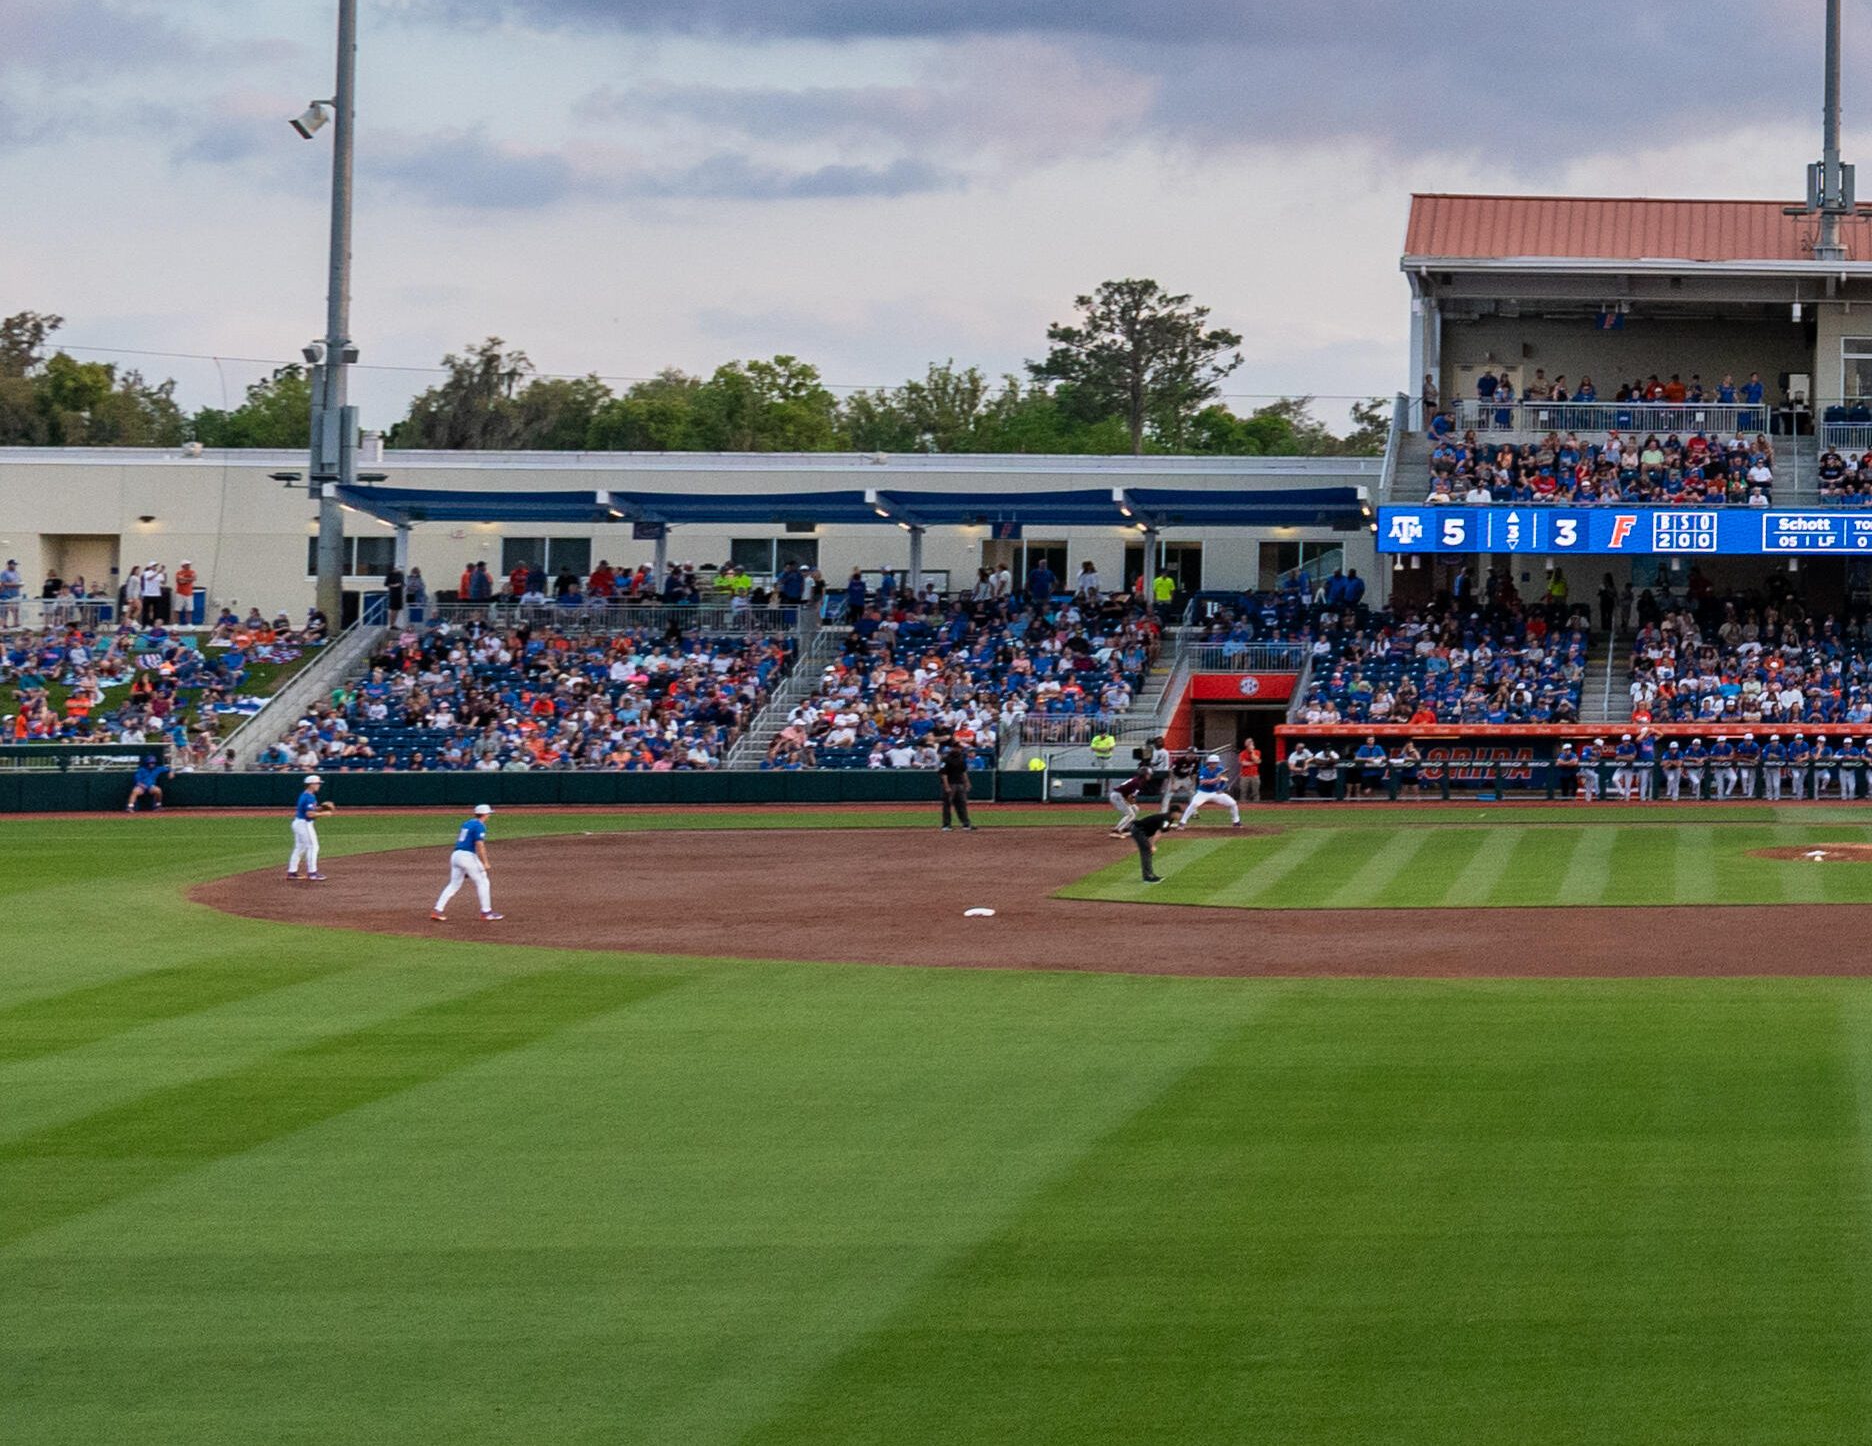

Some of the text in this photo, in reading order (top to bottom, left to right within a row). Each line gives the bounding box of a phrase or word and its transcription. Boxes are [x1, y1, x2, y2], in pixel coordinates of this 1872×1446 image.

[1442, 518, 1465, 545] 5
[1507, 525, 1519, 540] 3
[1555, 519, 1577, 546] 3
[1608, 515, 1637, 548] F
[1778, 518, 1831, 531] Schott
[1818, 536, 1835, 547] LF
[1382, 747, 1533, 780] FORIDA
